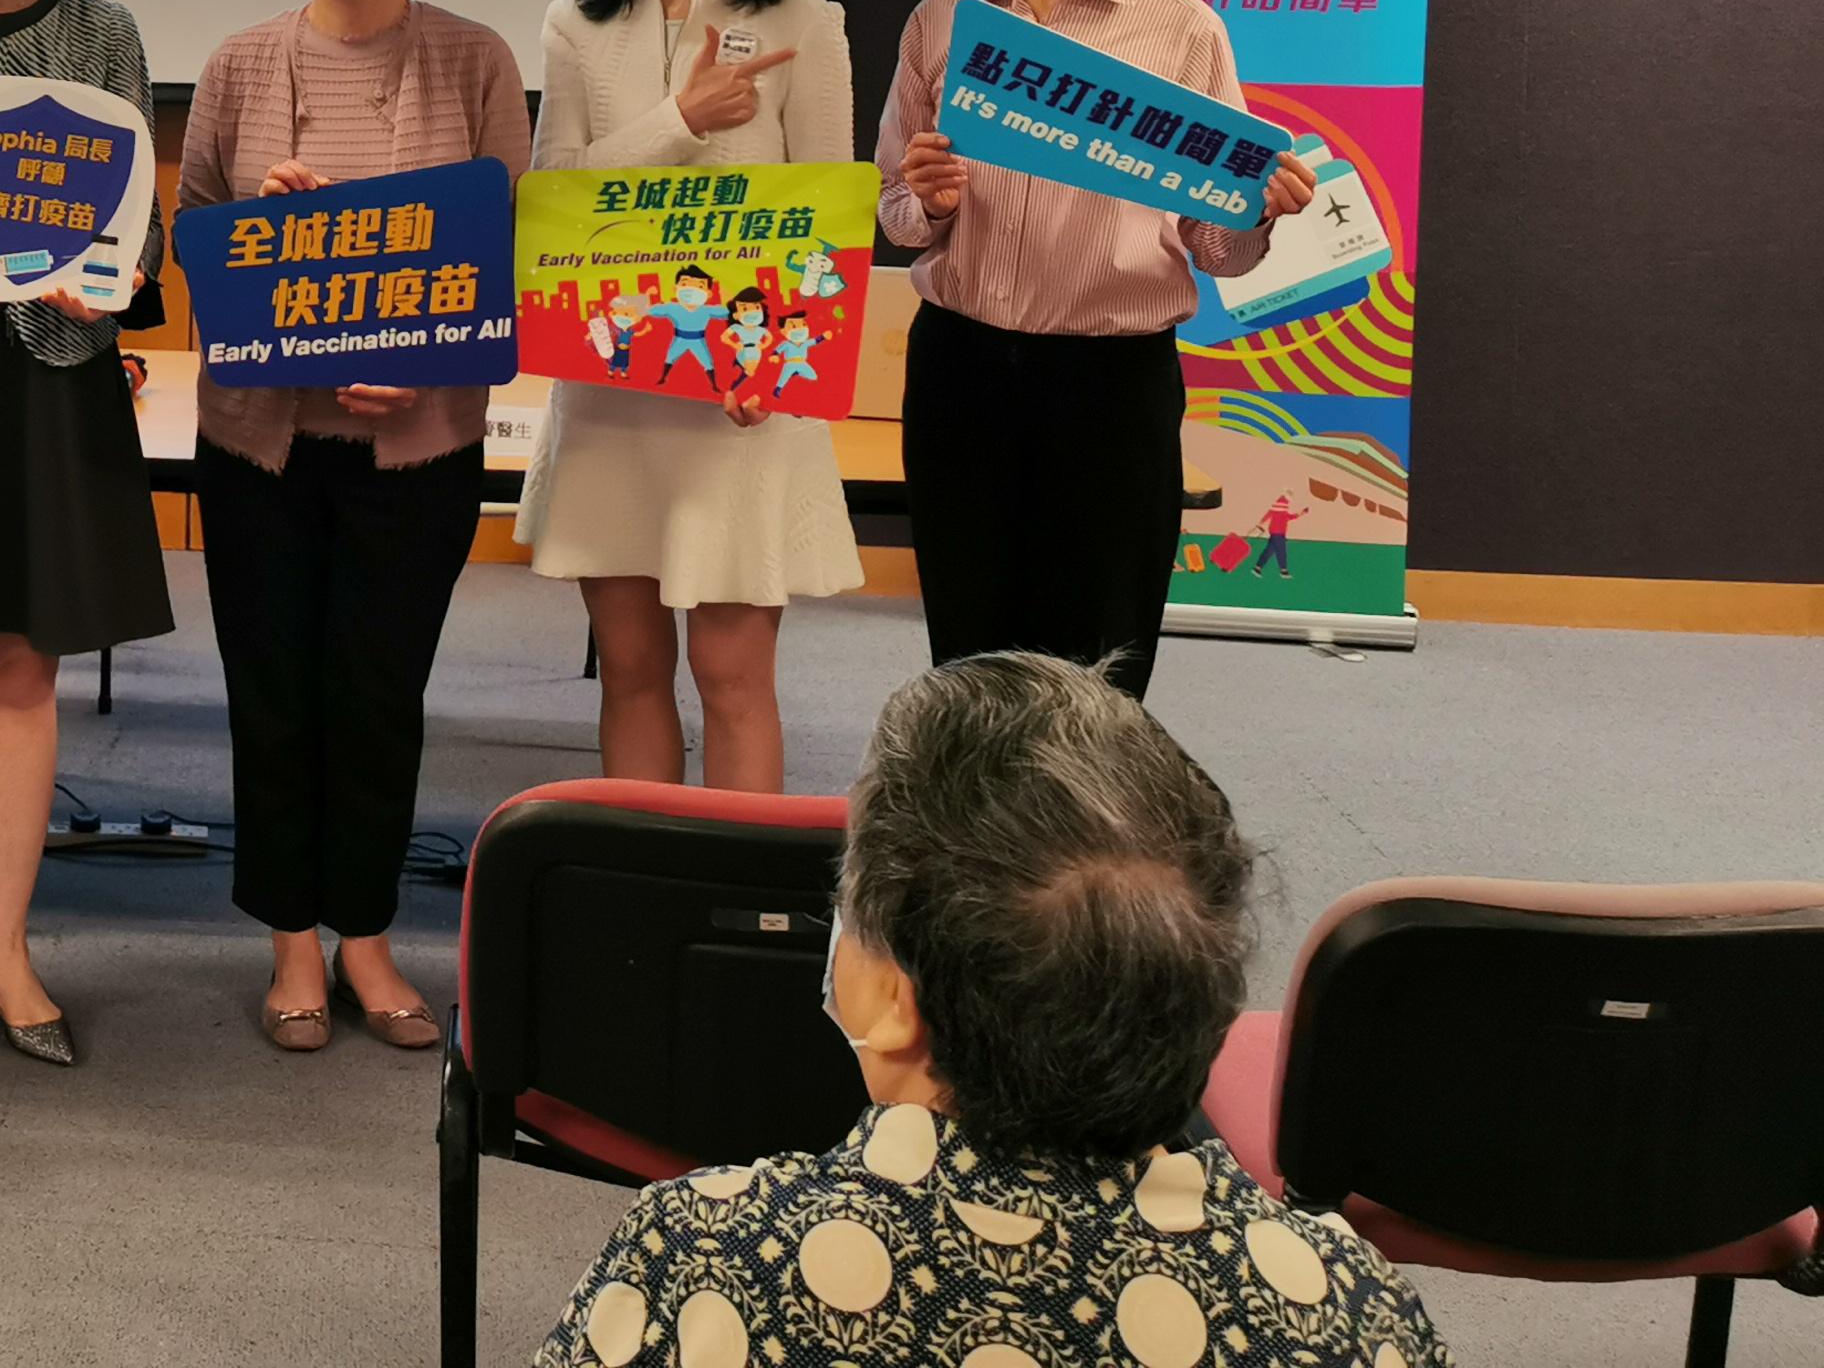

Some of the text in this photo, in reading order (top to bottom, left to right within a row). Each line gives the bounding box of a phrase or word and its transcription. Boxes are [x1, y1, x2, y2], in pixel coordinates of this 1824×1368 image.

[960, 42, 1276, 181] 點只打針咁簡單
[64, 134, 113, 163] 局長
[950, 86, 1249, 215] It's more than a Jab
[593, 173, 749, 214] 全城起動
[226, 202, 435, 269] 全城起動
[660, 206, 816, 246] 快打疫苗
[537, 246, 761, 269] Early Vaccination for All
[271, 263, 479, 328] 快打疫苗
[208, 317, 512, 364] Early Vaccination for All
